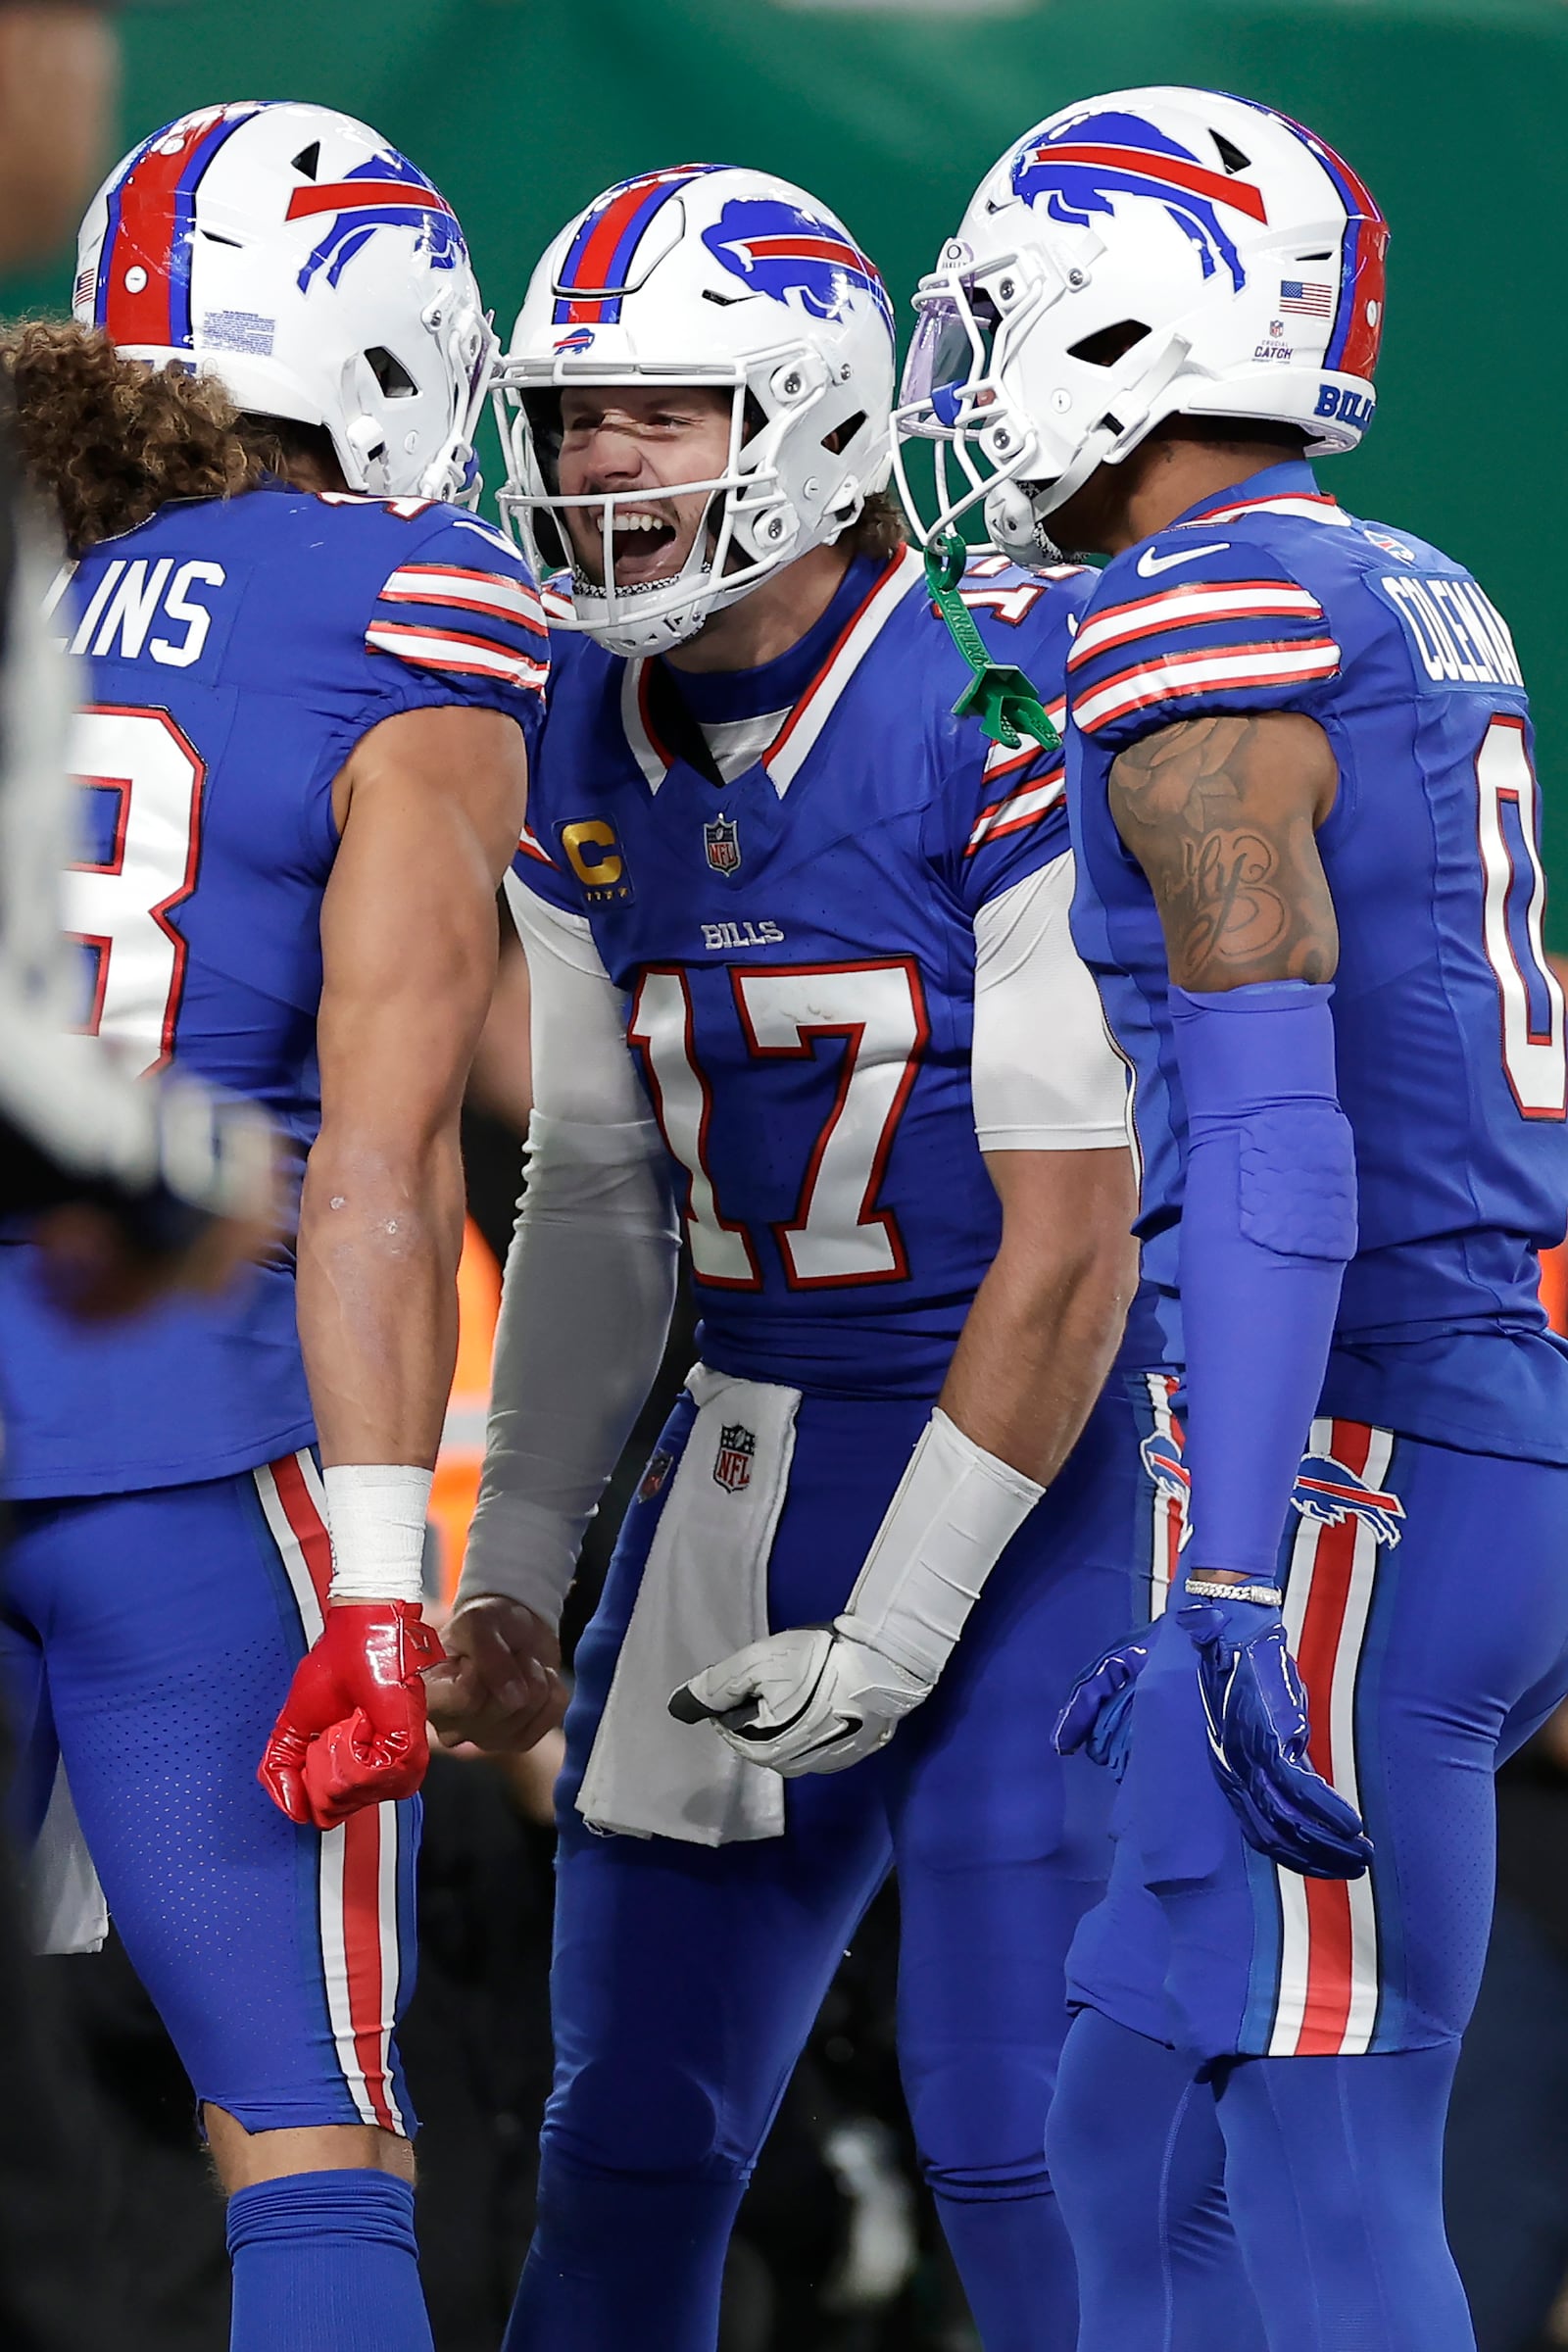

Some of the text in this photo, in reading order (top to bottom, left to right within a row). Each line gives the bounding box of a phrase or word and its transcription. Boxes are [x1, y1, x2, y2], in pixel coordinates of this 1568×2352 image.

[1254, 345, 1294, 360] CATCH
[562, 820, 622, 885] C
[708, 842, 737, 866] NFL
[701, 920, 784, 950] BILLS
[1475, 711, 1568, 1123] 0
[627, 956, 929, 1291] 17
[716, 1449, 751, 1488] NFL
